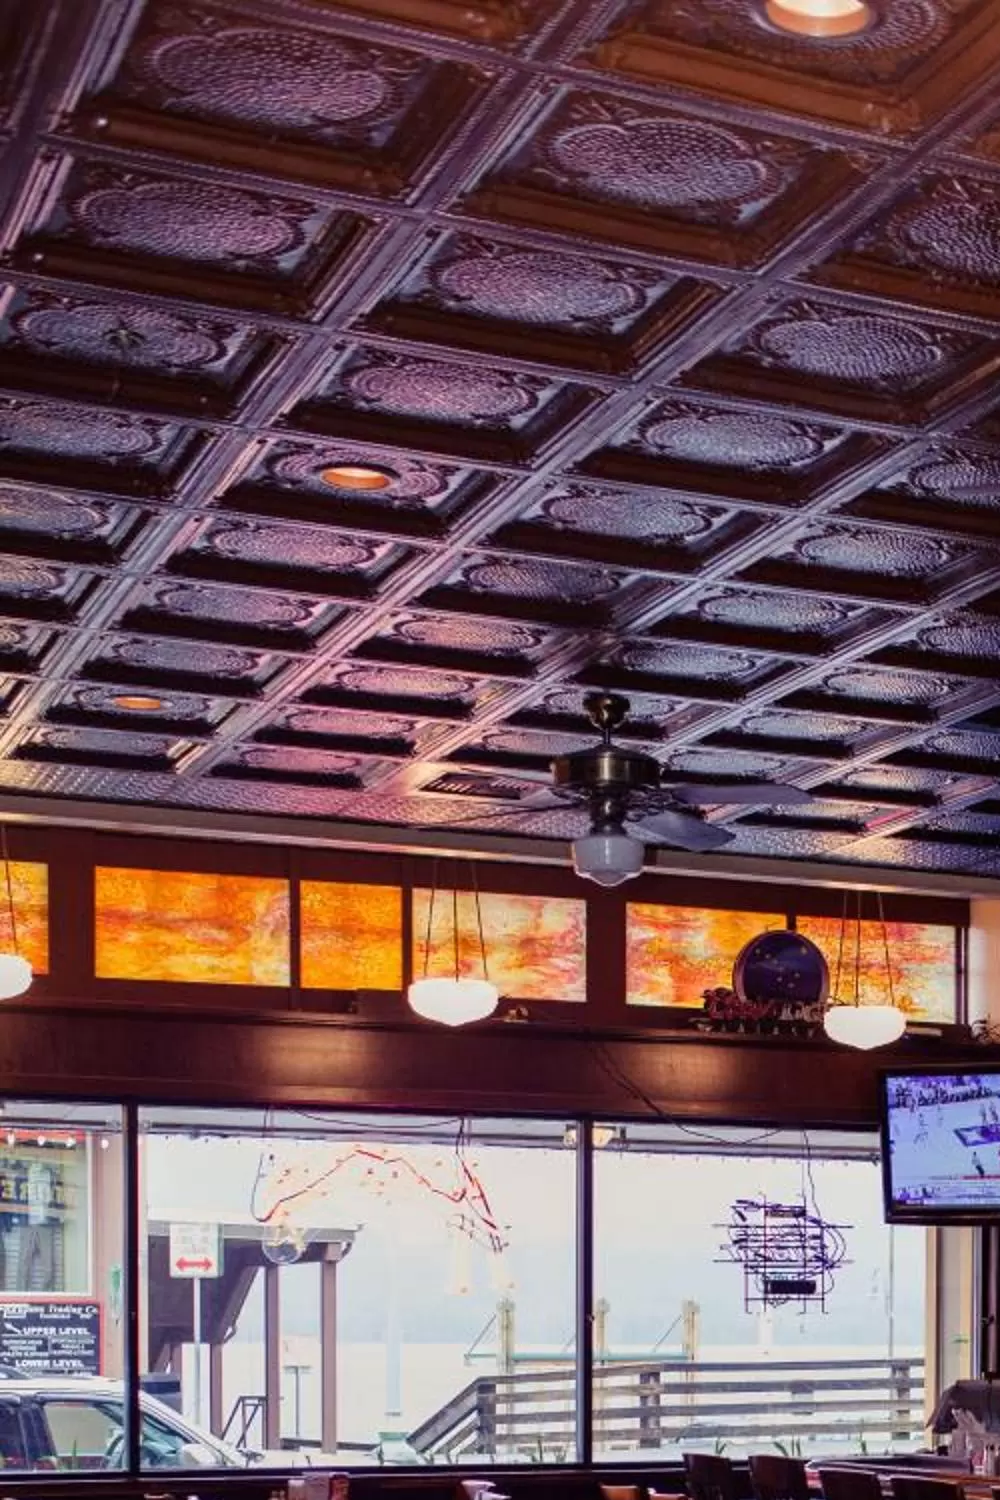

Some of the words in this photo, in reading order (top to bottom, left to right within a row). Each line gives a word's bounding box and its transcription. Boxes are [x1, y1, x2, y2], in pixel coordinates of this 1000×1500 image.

[23, 1327, 56, 1335] UPPER
[59, 1327, 90, 1335] LEVEL
[15, 1360, 50, 1368] LOWER
[53, 1360, 84, 1368] LEVEL
